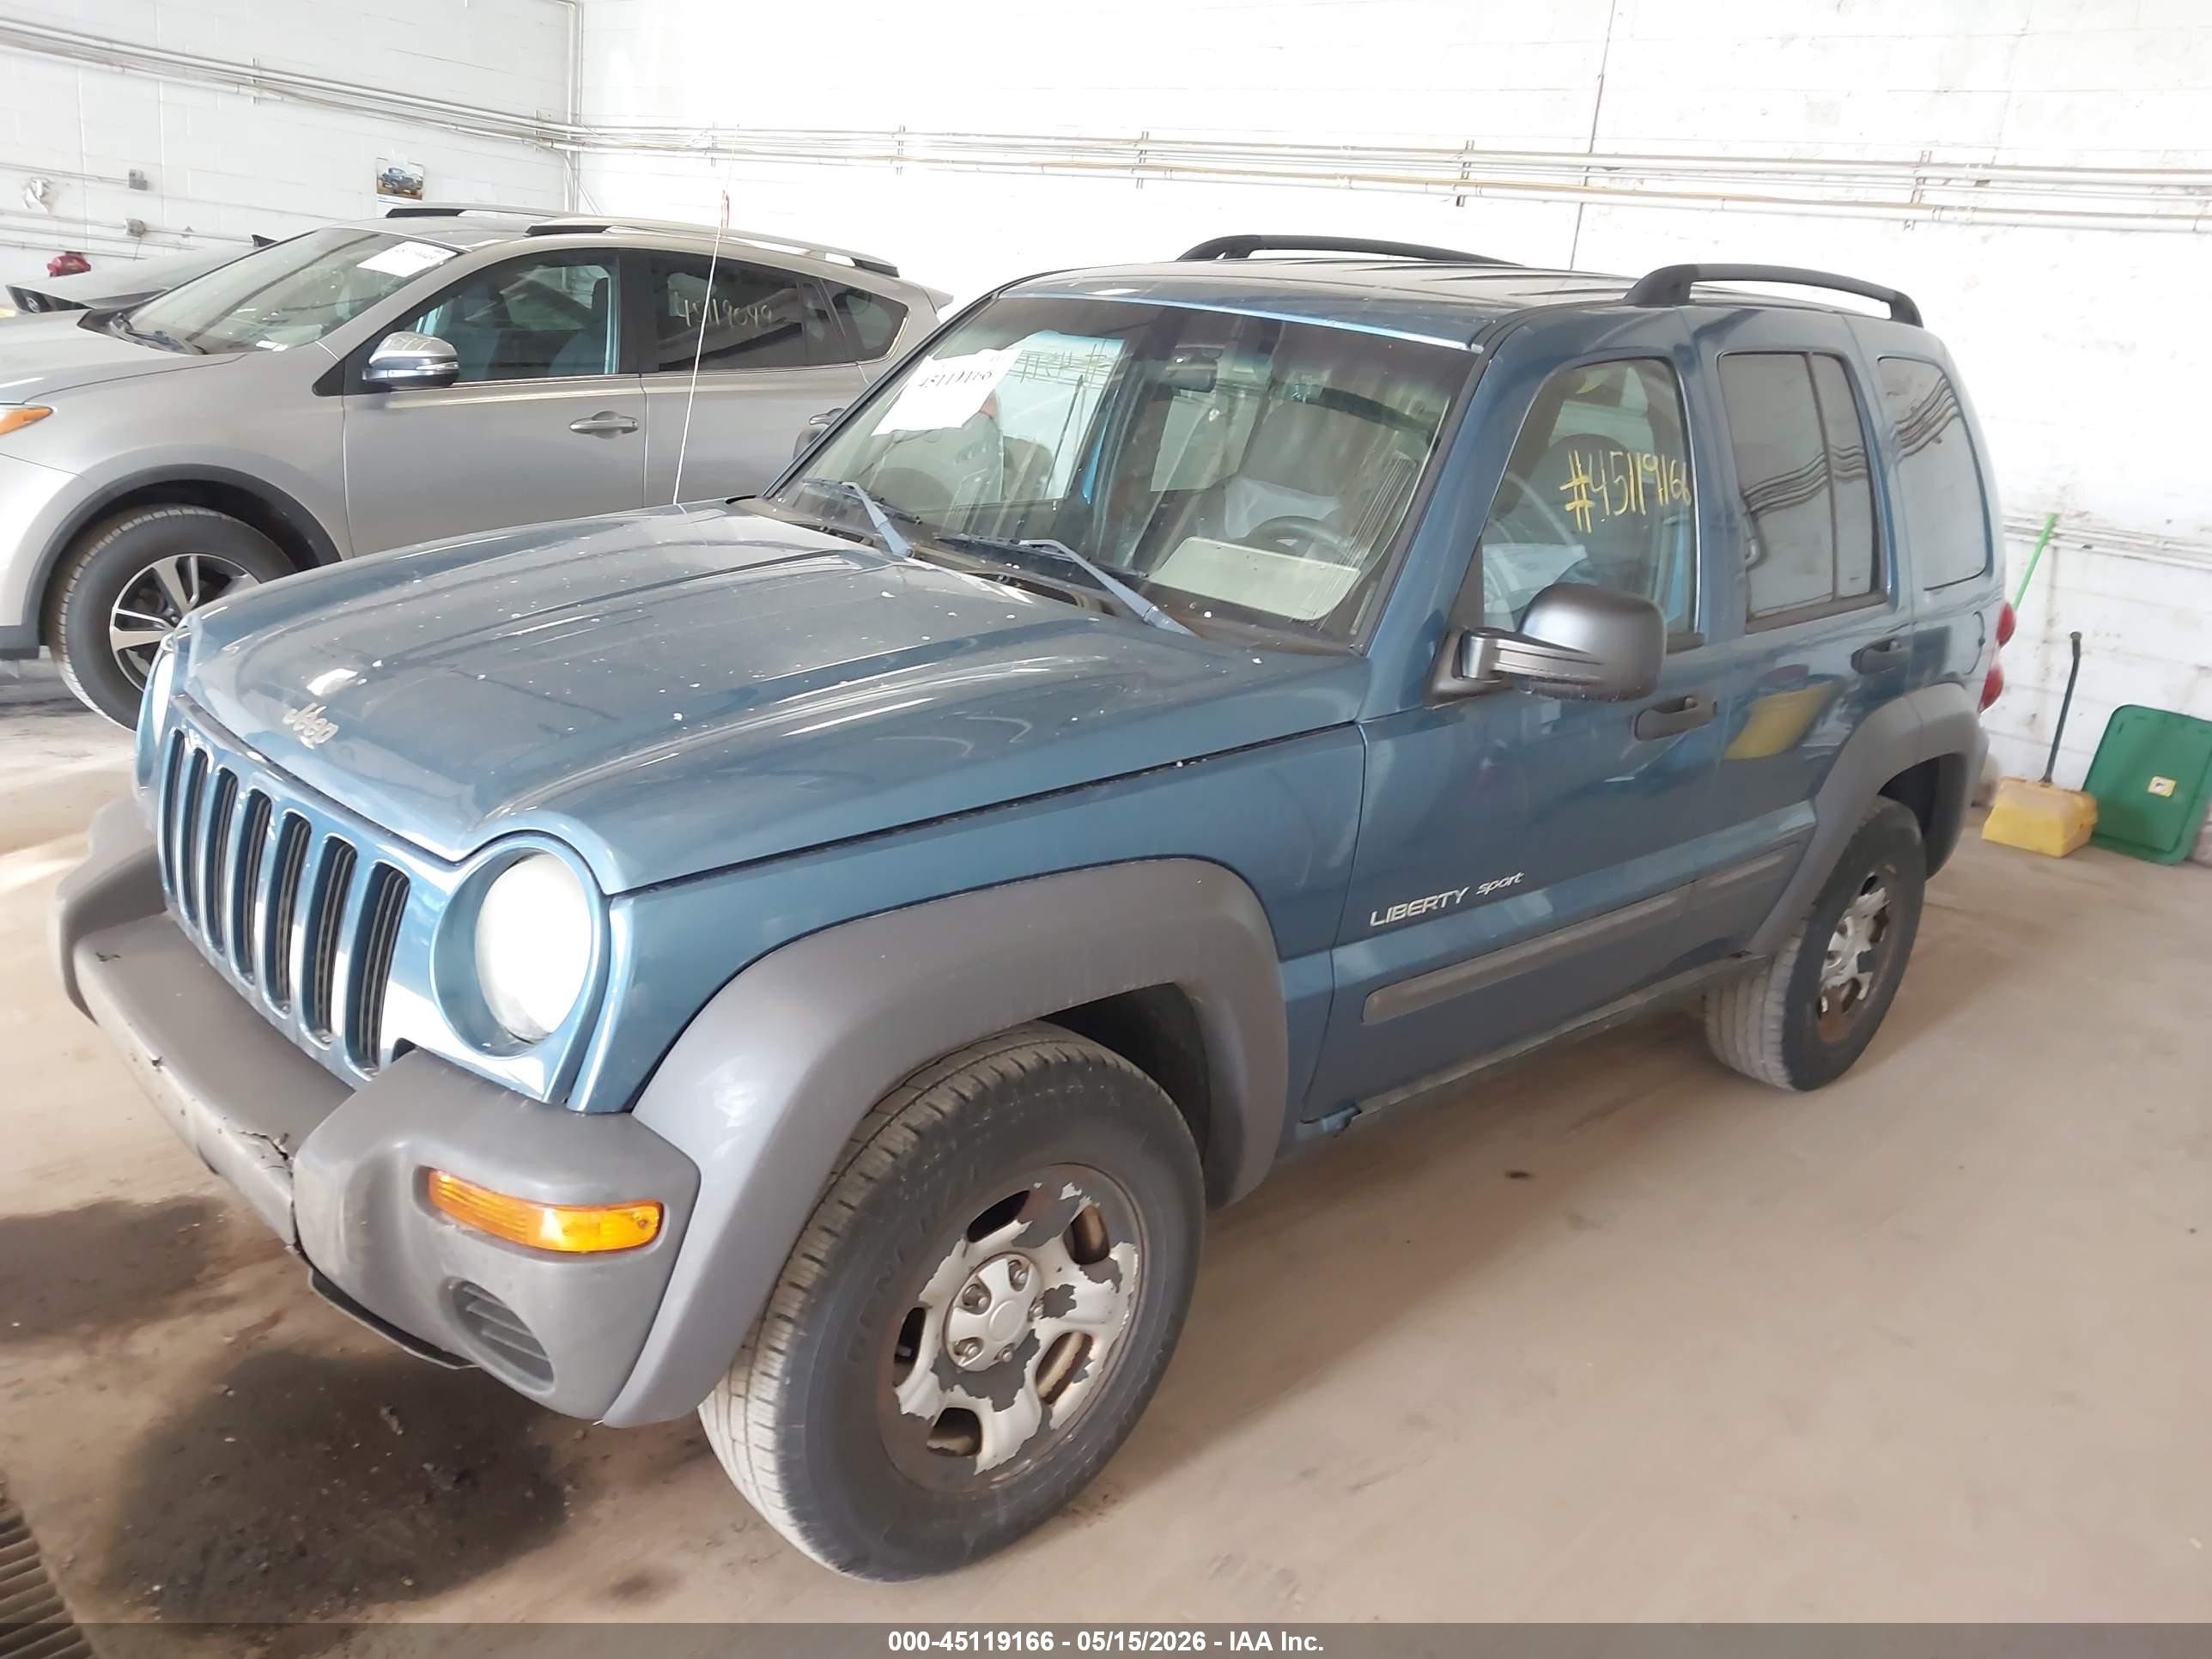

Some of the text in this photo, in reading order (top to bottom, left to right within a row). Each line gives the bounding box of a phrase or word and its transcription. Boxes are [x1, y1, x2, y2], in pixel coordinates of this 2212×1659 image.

[1559, 449, 1692, 533] #45119166
[282, 702, 339, 750] Jeep
[1370, 886, 1470, 927] LIBERTY
